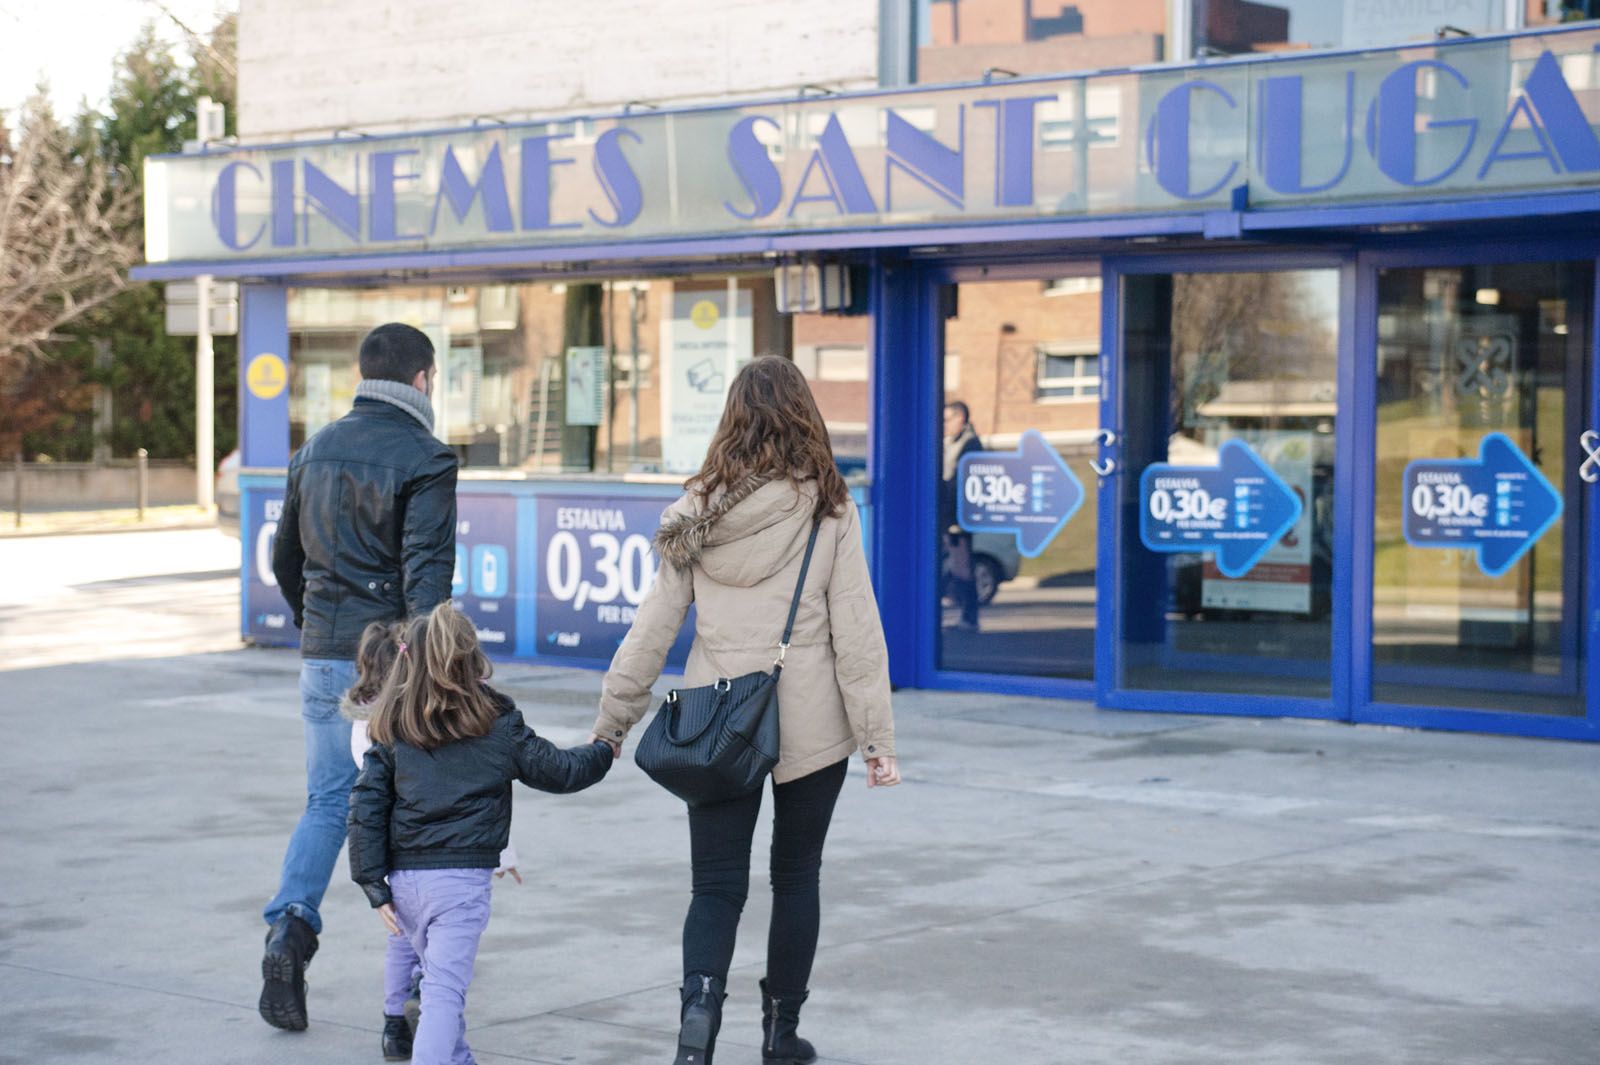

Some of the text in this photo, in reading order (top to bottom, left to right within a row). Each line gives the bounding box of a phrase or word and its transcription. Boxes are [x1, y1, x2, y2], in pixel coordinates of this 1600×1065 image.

[211, 43, 1600, 252] CINEMES SANT CUGA
[964, 475, 1026, 507] 0,30€
[1155, 478, 1199, 489] ESTALVIA
[1150, 489, 1227, 524] 0,30€
[1412, 484, 1488, 520] 0,30€
[556, 507, 626, 531] ESTALVIA
[546, 530, 658, 611] 0,30
[597, 605, 639, 624] PER EN
